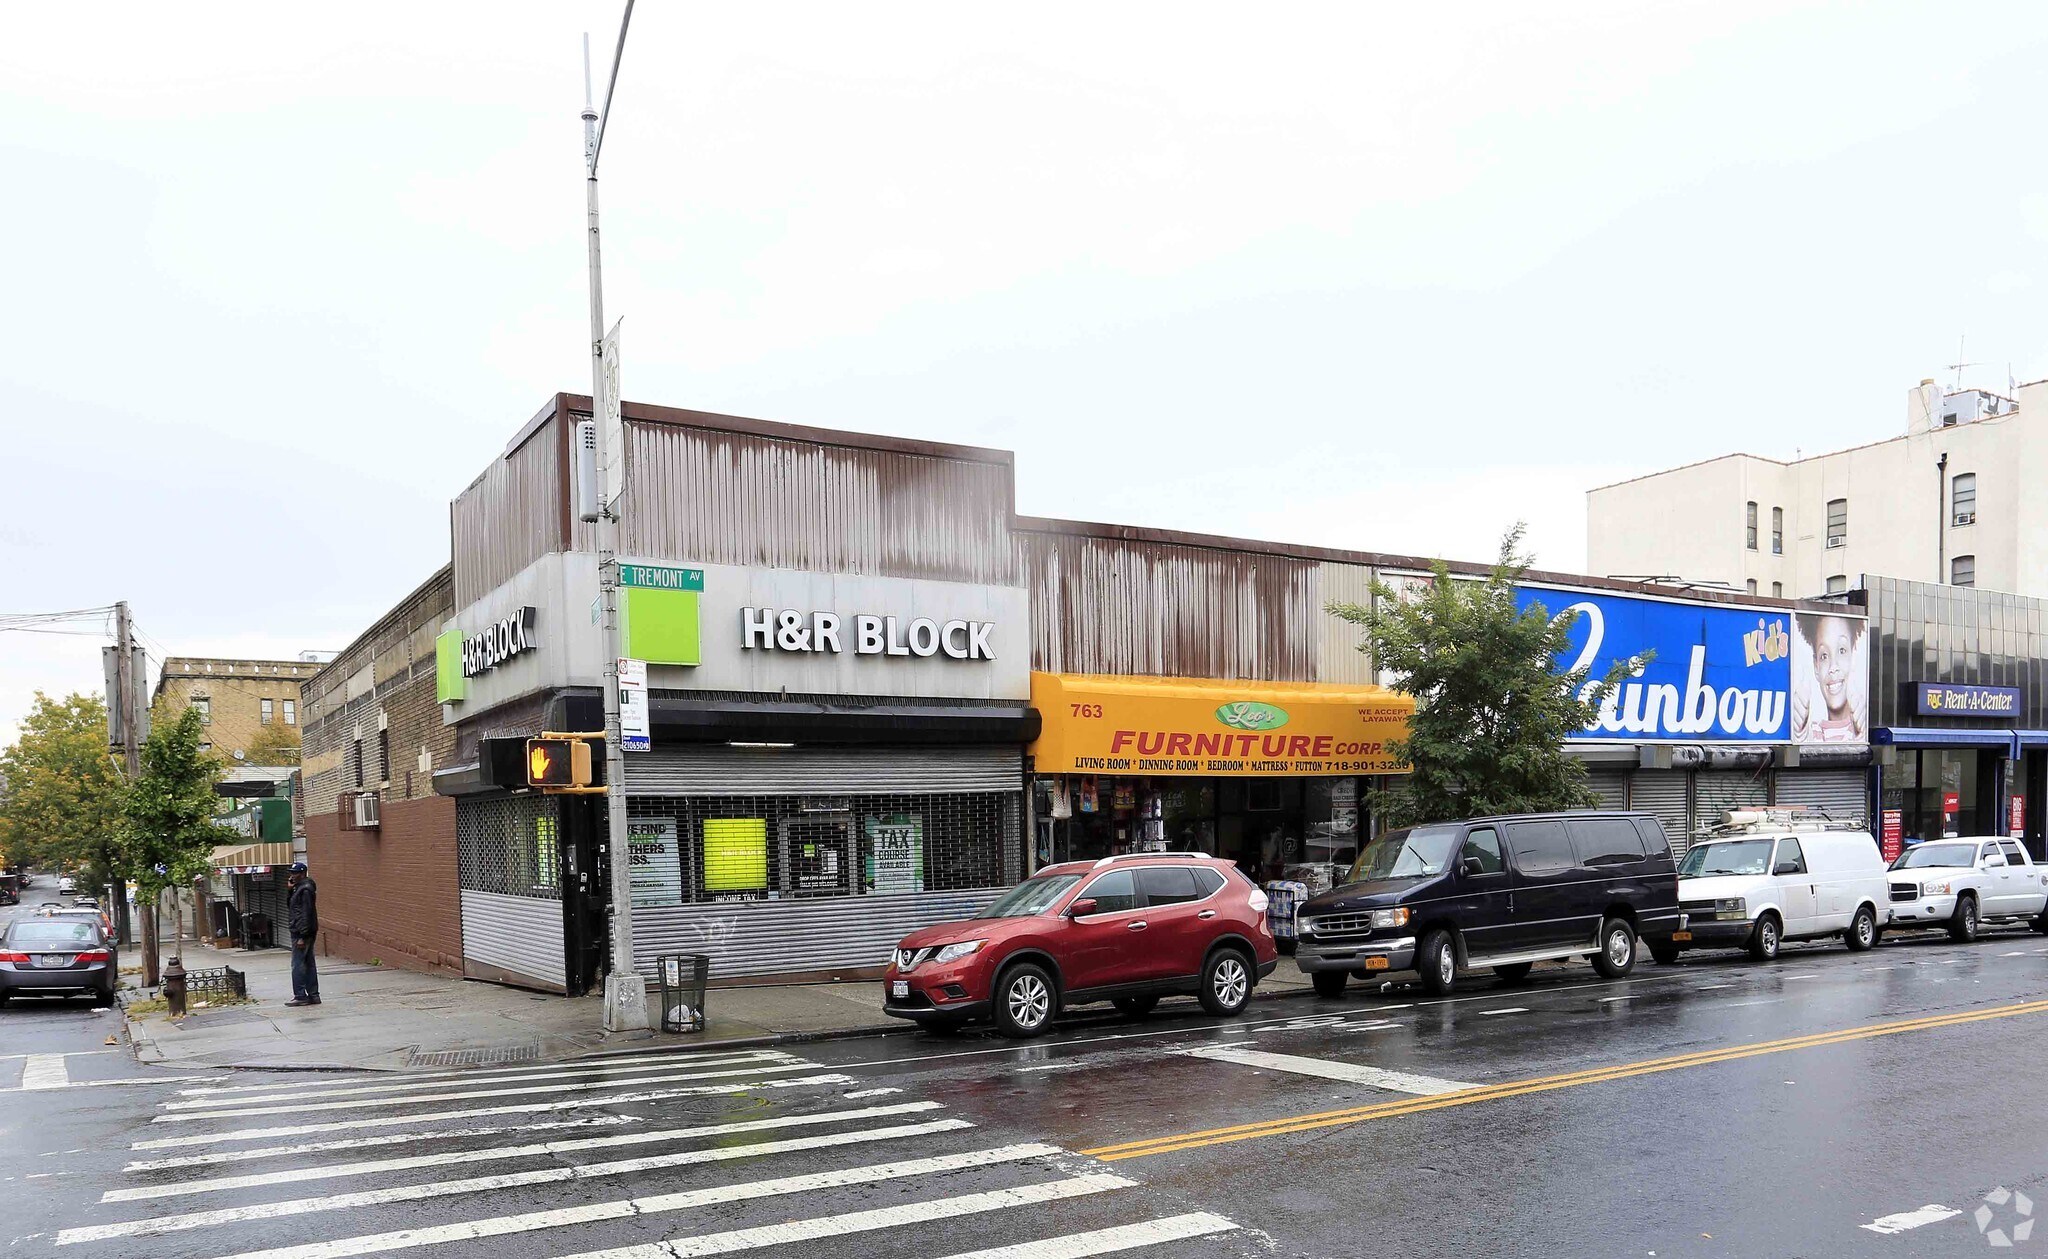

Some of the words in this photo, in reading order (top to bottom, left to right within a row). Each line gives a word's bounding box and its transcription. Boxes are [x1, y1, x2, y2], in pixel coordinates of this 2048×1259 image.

[620, 567, 627, 584] E
[632, 567, 684, 588] TREMONT
[689, 572, 701, 581] AV
[461, 632, 485, 678] H&R
[486, 605, 532, 667] BLOCK
[740, 606, 843, 654] H&R
[853, 613, 998, 661] BLOCK
[1743, 617, 1789, 668] Kid's
[1070, 703, 1103, 719] 763
[1110, 730, 1334, 757] FURNITURE
[1335, 743, 1382, 755] CORP.
[1075, 757, 1105, 769] LIVING
[1106, 758, 1131, 770] ROOM
[1138, 759, 1174, 771] DINNING
[1175, 759, 1199, 771] ROOM
[1207, 760, 1244, 771] BEDROOM
[1251, 760, 1288, 771] MATTRESS
[1295, 760, 1322, 771] FUTTON
[628, 844, 665, 854] THERS
[879, 829, 910, 850] TAX
[879, 850, 911, 860] COURSE
[879, 861, 911, 869] AVAILABLE
